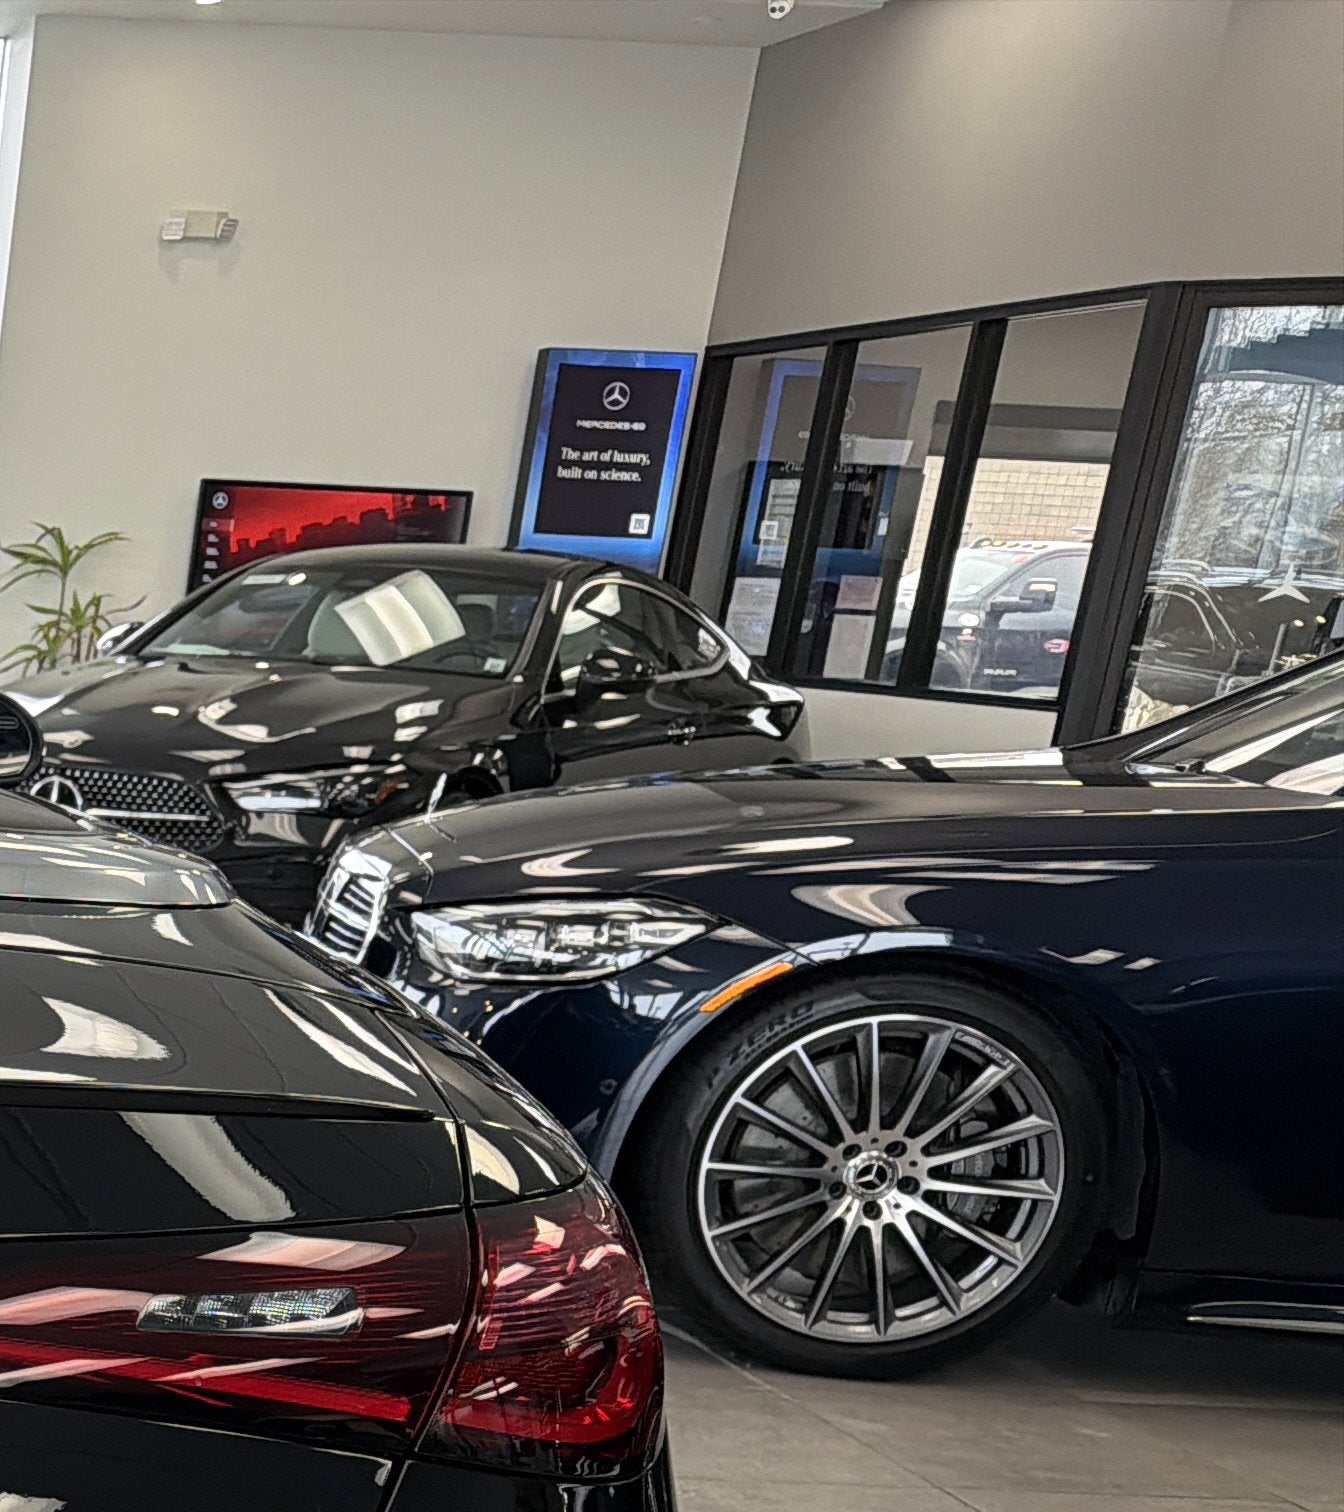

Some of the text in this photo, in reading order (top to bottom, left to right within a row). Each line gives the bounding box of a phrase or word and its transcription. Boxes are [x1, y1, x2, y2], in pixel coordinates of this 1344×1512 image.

[561, 446, 650, 467] The art of luxury,
[557, 465, 642, 482] built on science.
